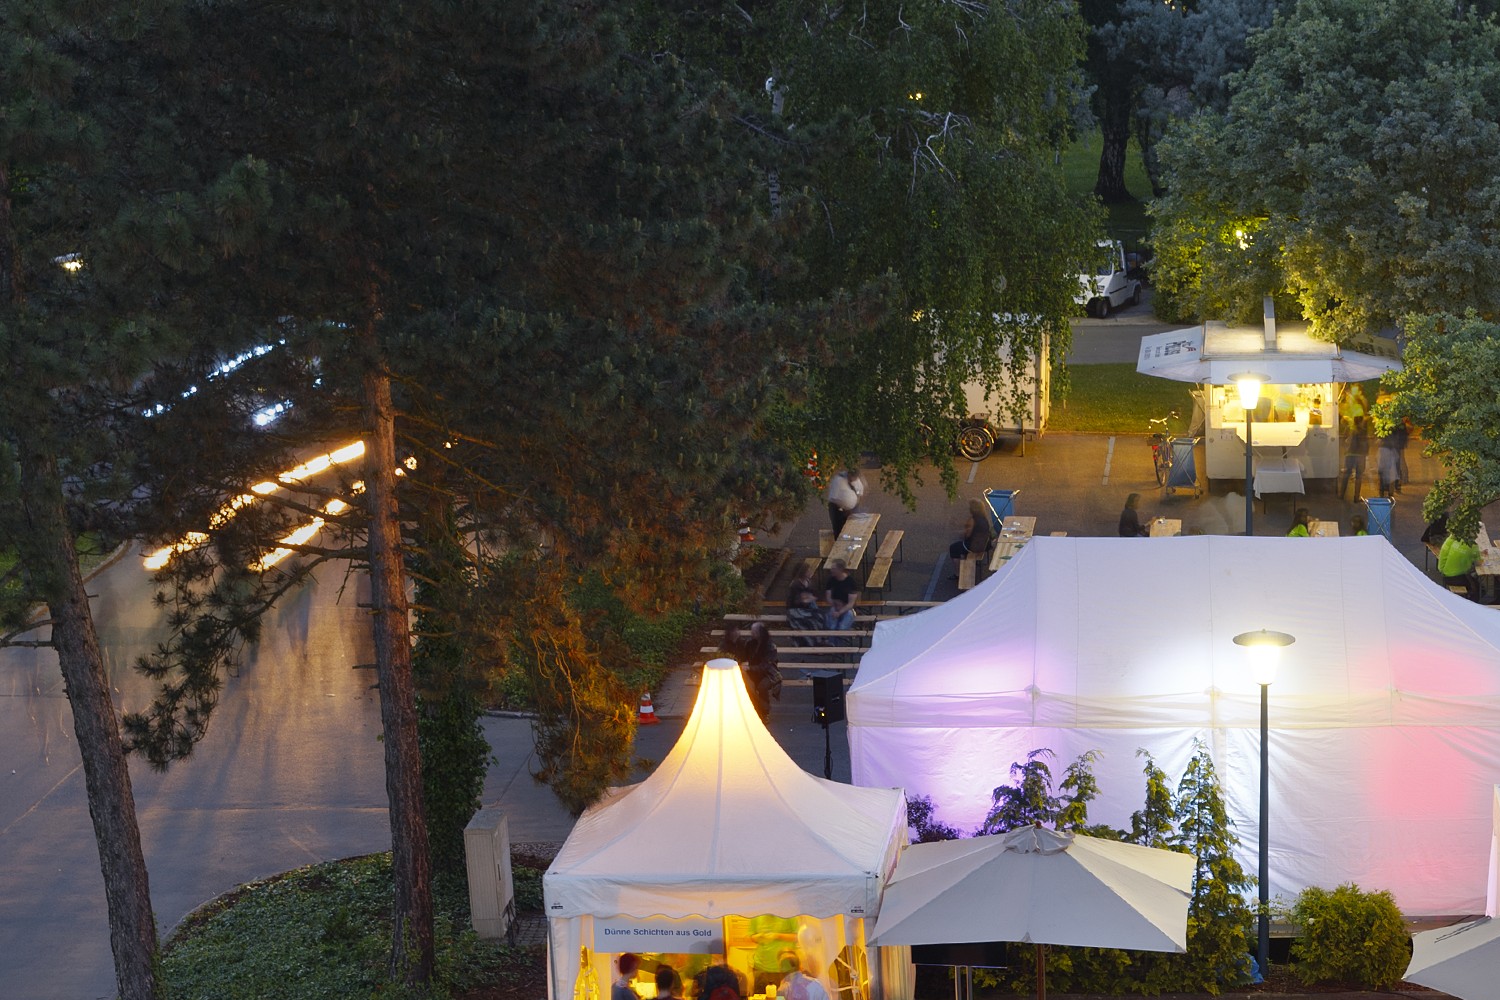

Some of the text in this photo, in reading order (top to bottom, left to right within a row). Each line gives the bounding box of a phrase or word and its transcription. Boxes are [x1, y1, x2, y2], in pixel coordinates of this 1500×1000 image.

[604, 928, 631, 936] Dünne
[633, 928, 674, 936] Schichten
[692, 929, 712, 937] Gold
